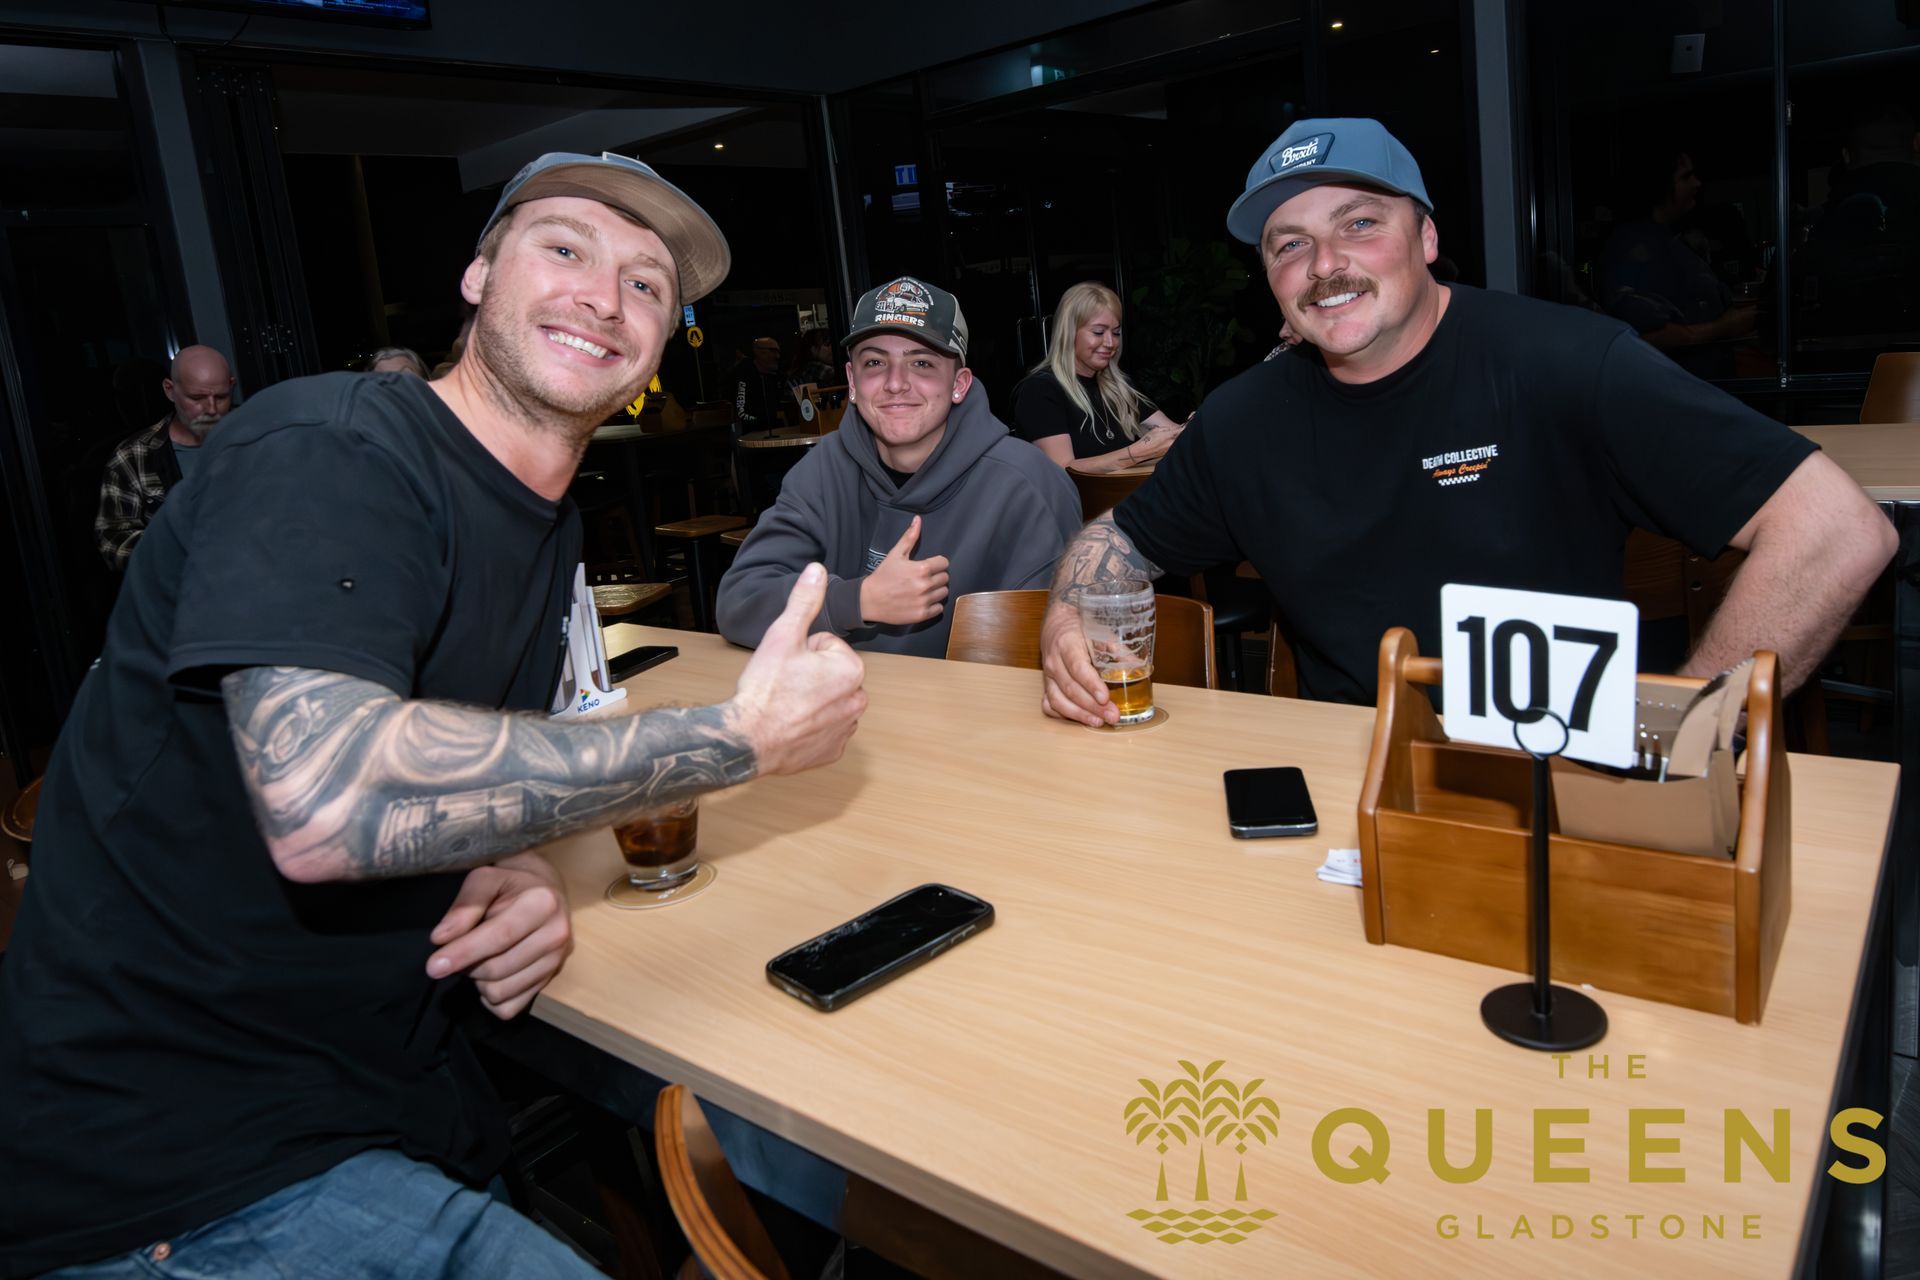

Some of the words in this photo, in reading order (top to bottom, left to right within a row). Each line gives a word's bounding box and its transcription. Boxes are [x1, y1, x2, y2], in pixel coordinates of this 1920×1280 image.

[874, 313, 926, 327] RINGERS
[1444, 444, 1499, 465] COLLECTIVE
[1456, 615, 1619, 734] 107
[577, 699, 601, 714] KENO
